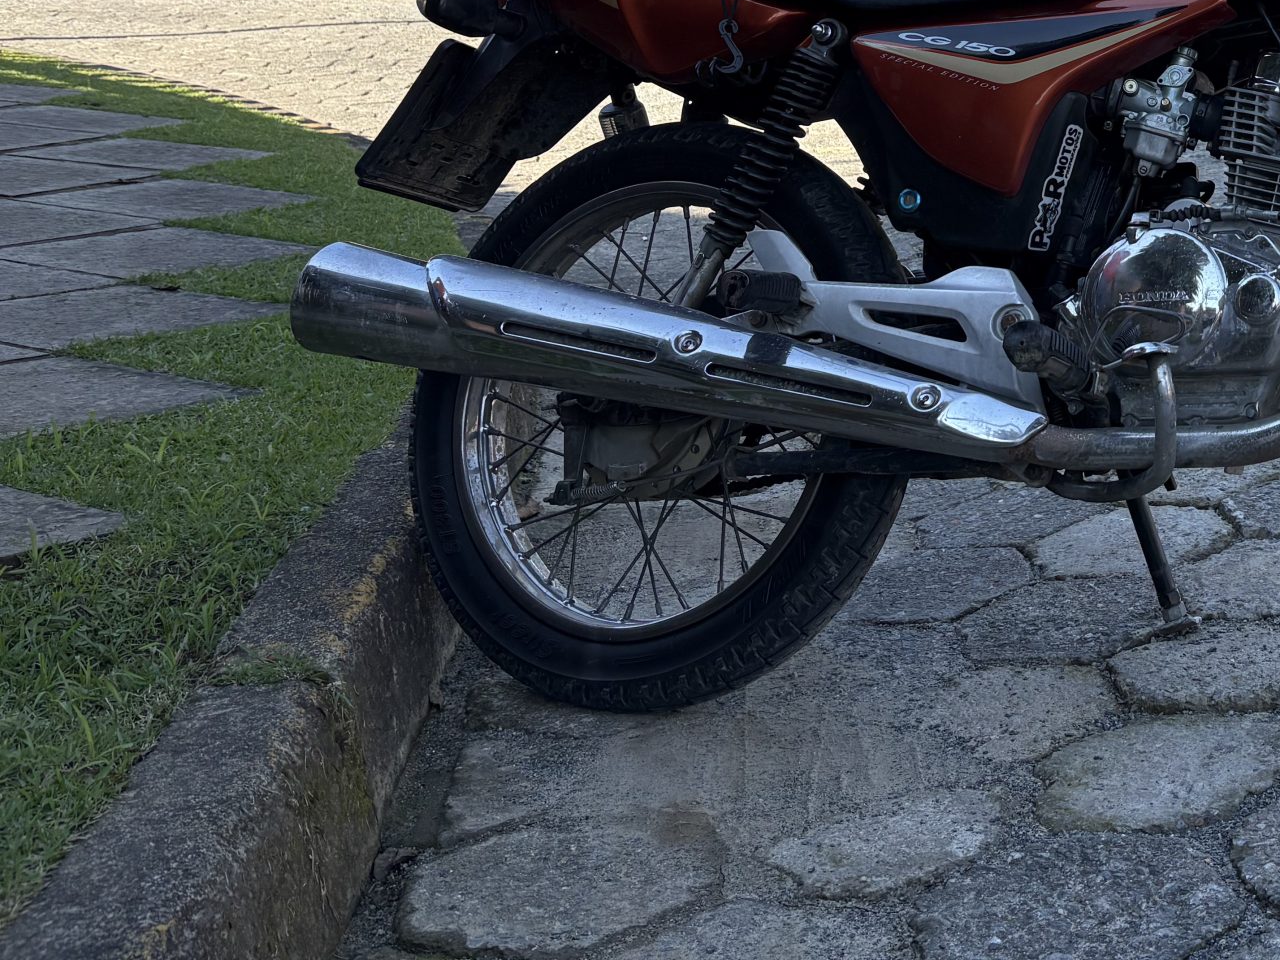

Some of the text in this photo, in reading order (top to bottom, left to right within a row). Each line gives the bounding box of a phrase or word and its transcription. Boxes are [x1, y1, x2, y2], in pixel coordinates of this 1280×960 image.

[898, 32, 1016, 57] CG 150
[879, 53, 1000, 92] SPECIAL EDITION
[1055, 127, 1078, 178] MOTOS
[1118, 289, 1190, 304] HONDA
